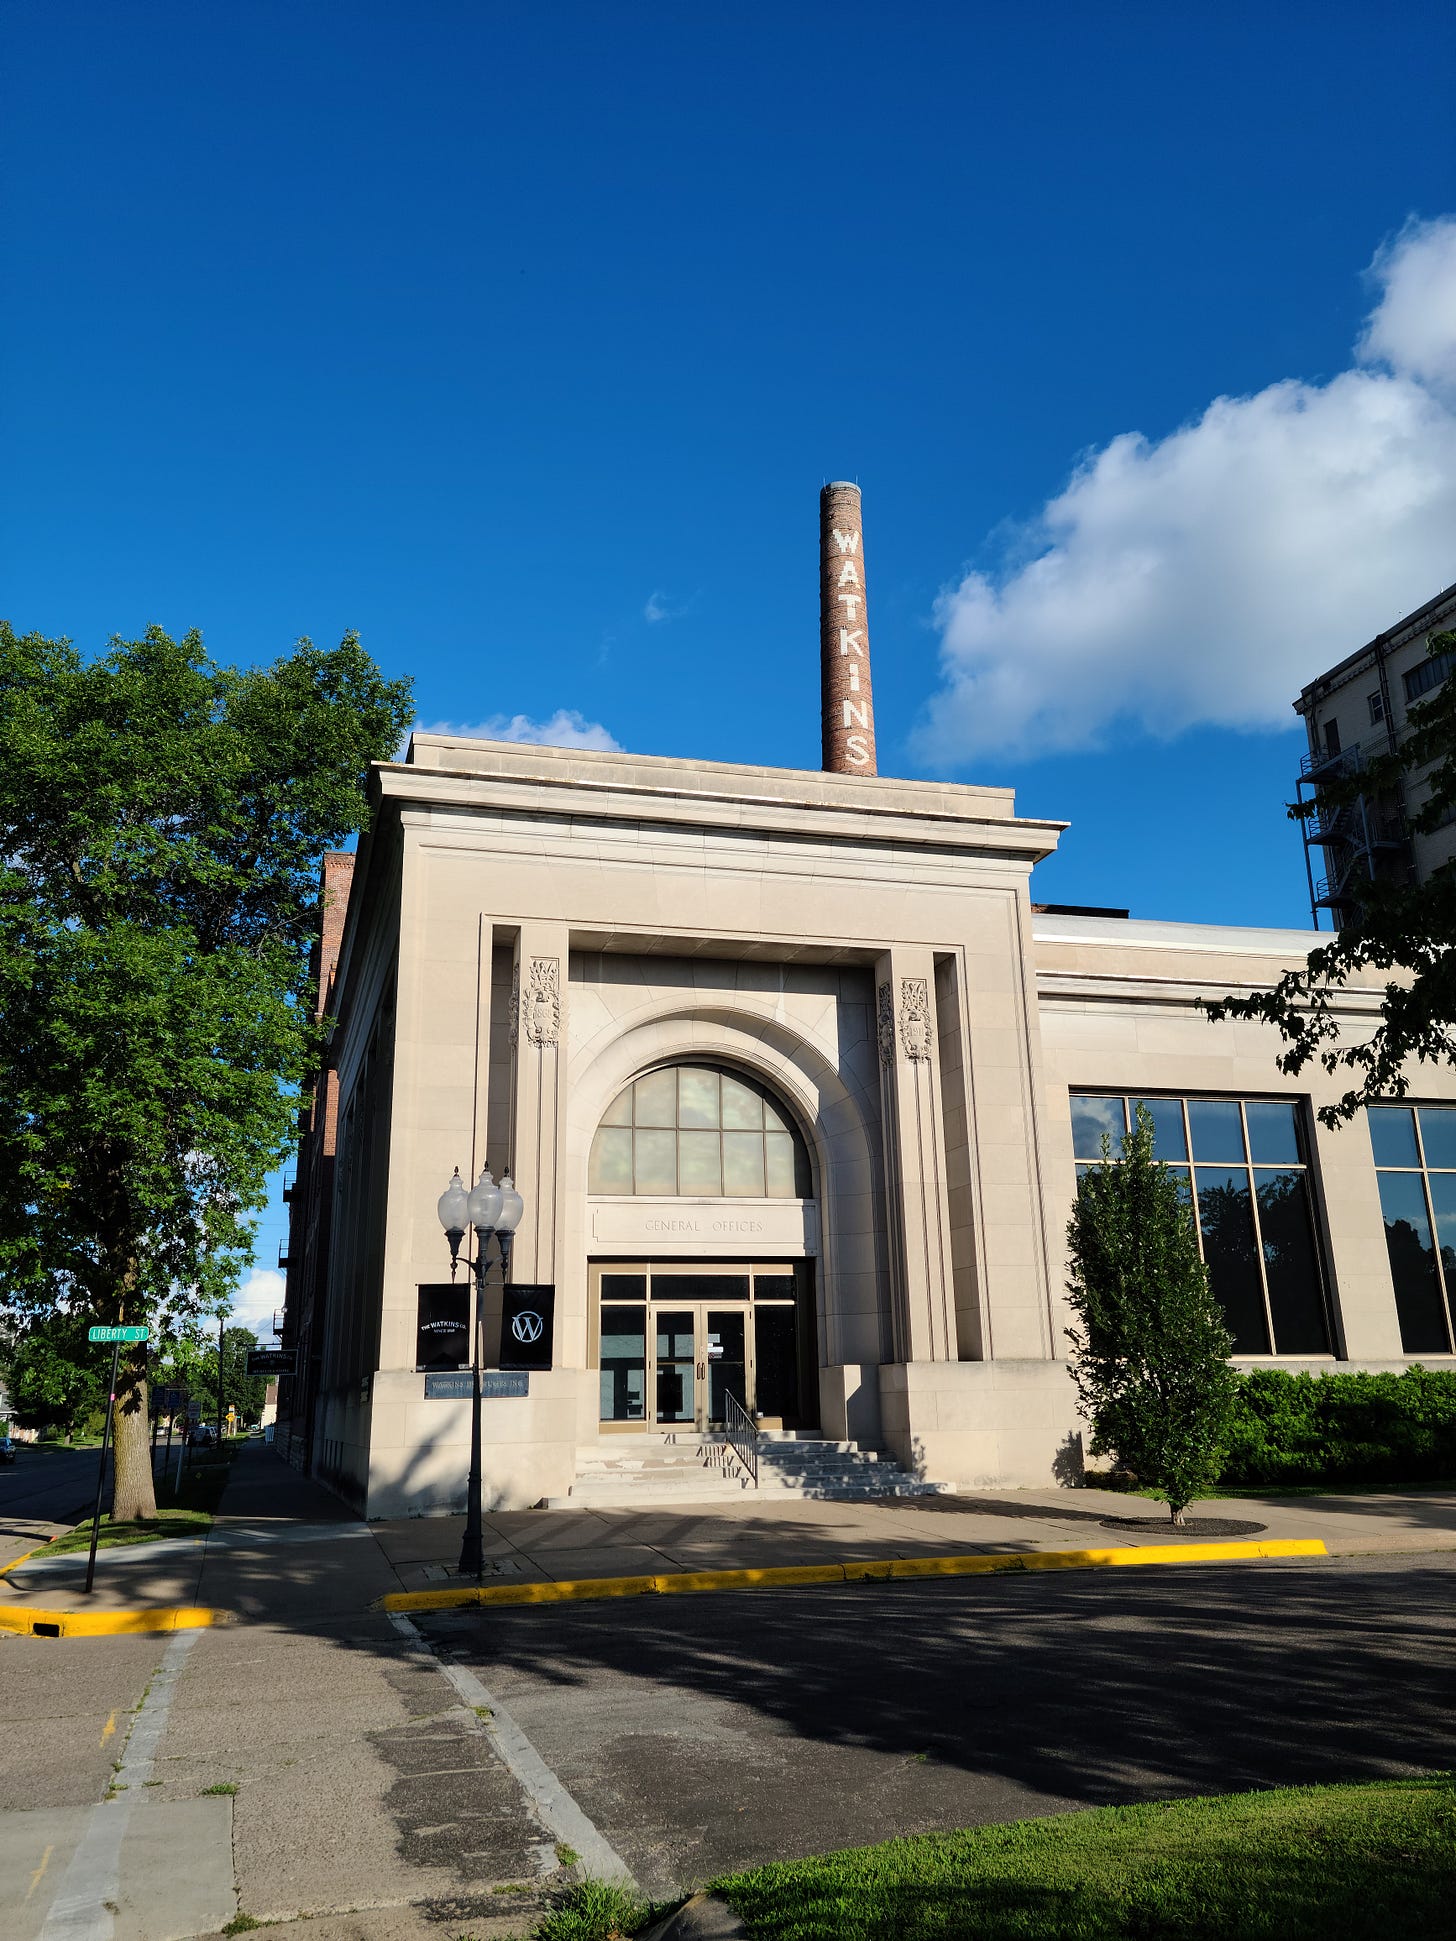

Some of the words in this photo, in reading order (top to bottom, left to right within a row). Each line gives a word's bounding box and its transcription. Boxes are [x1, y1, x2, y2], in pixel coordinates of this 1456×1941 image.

[832, 528, 870, 766] WATKINS
[645, 1220, 701, 1232] GENERAL
[712, 1221, 764, 1232] OFFICES
[92, 1329, 128, 1340] LIBERTY
[134, 1329, 145, 1339] ST
[431, 1381, 464, 1390] WATKINS
